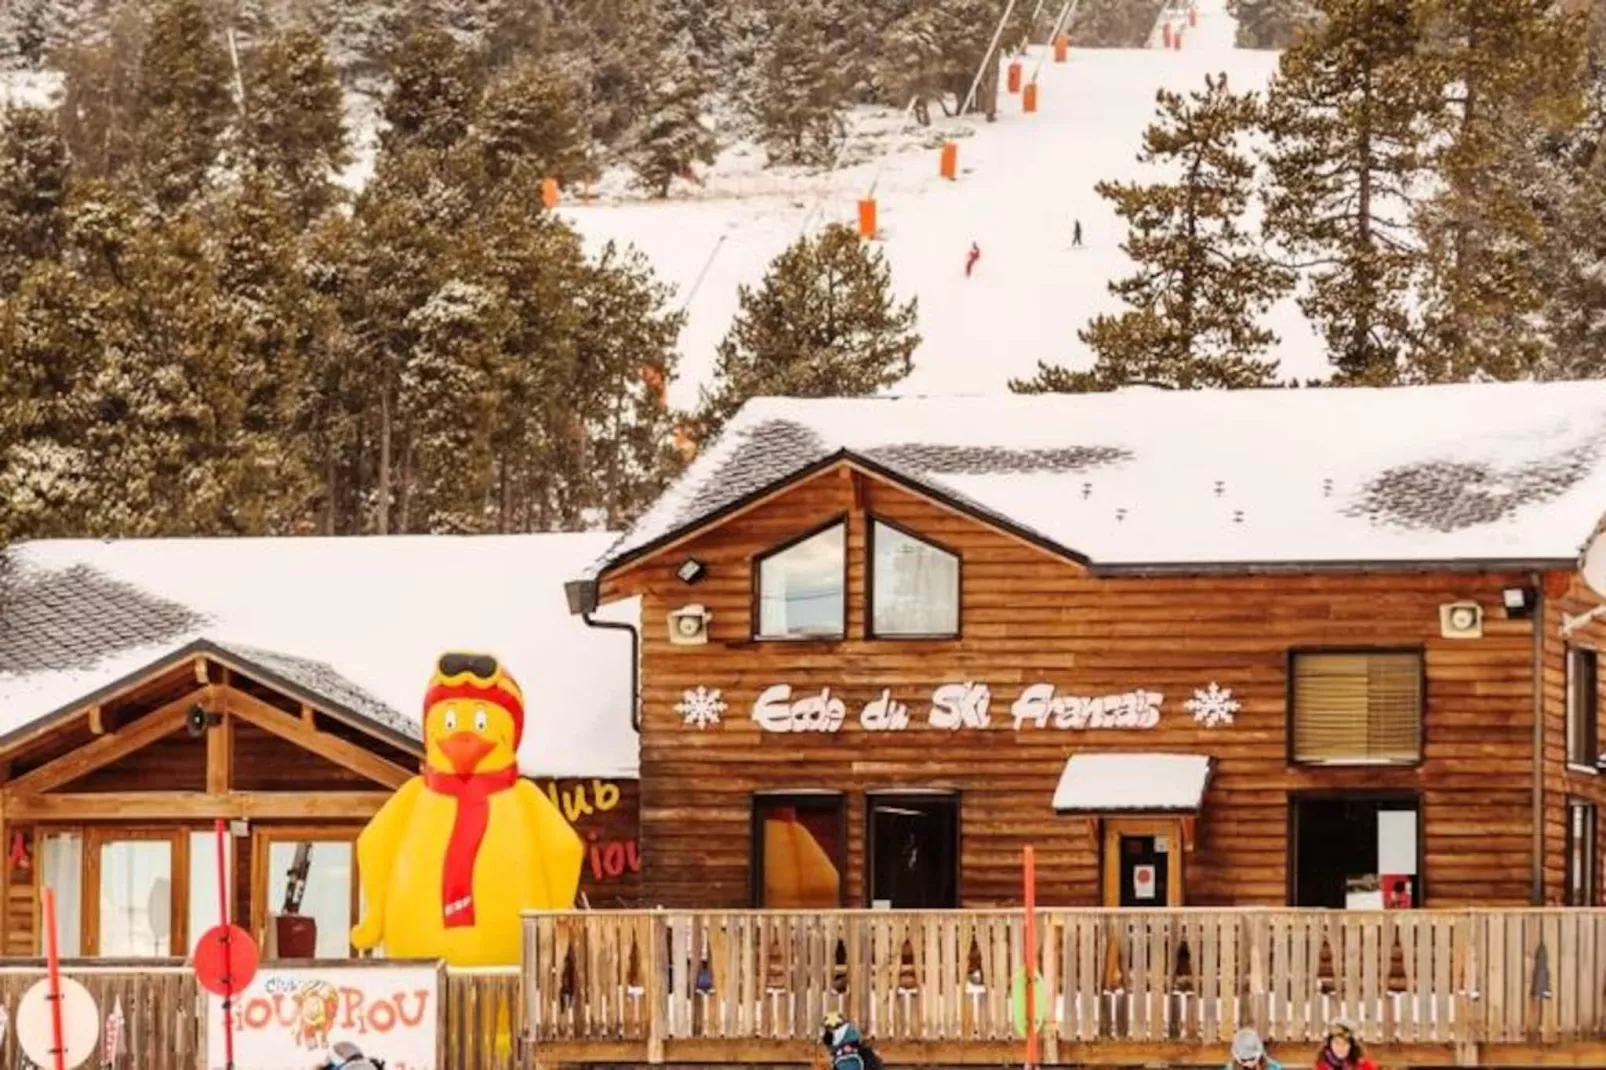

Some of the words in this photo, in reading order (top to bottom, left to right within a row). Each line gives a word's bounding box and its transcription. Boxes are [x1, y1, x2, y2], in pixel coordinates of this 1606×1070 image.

[752, 684, 846, 732] Ecole
[860, 688, 909, 730] du
[928, 681, 991, 730] Ski
[547, 780, 619, 822] lub
